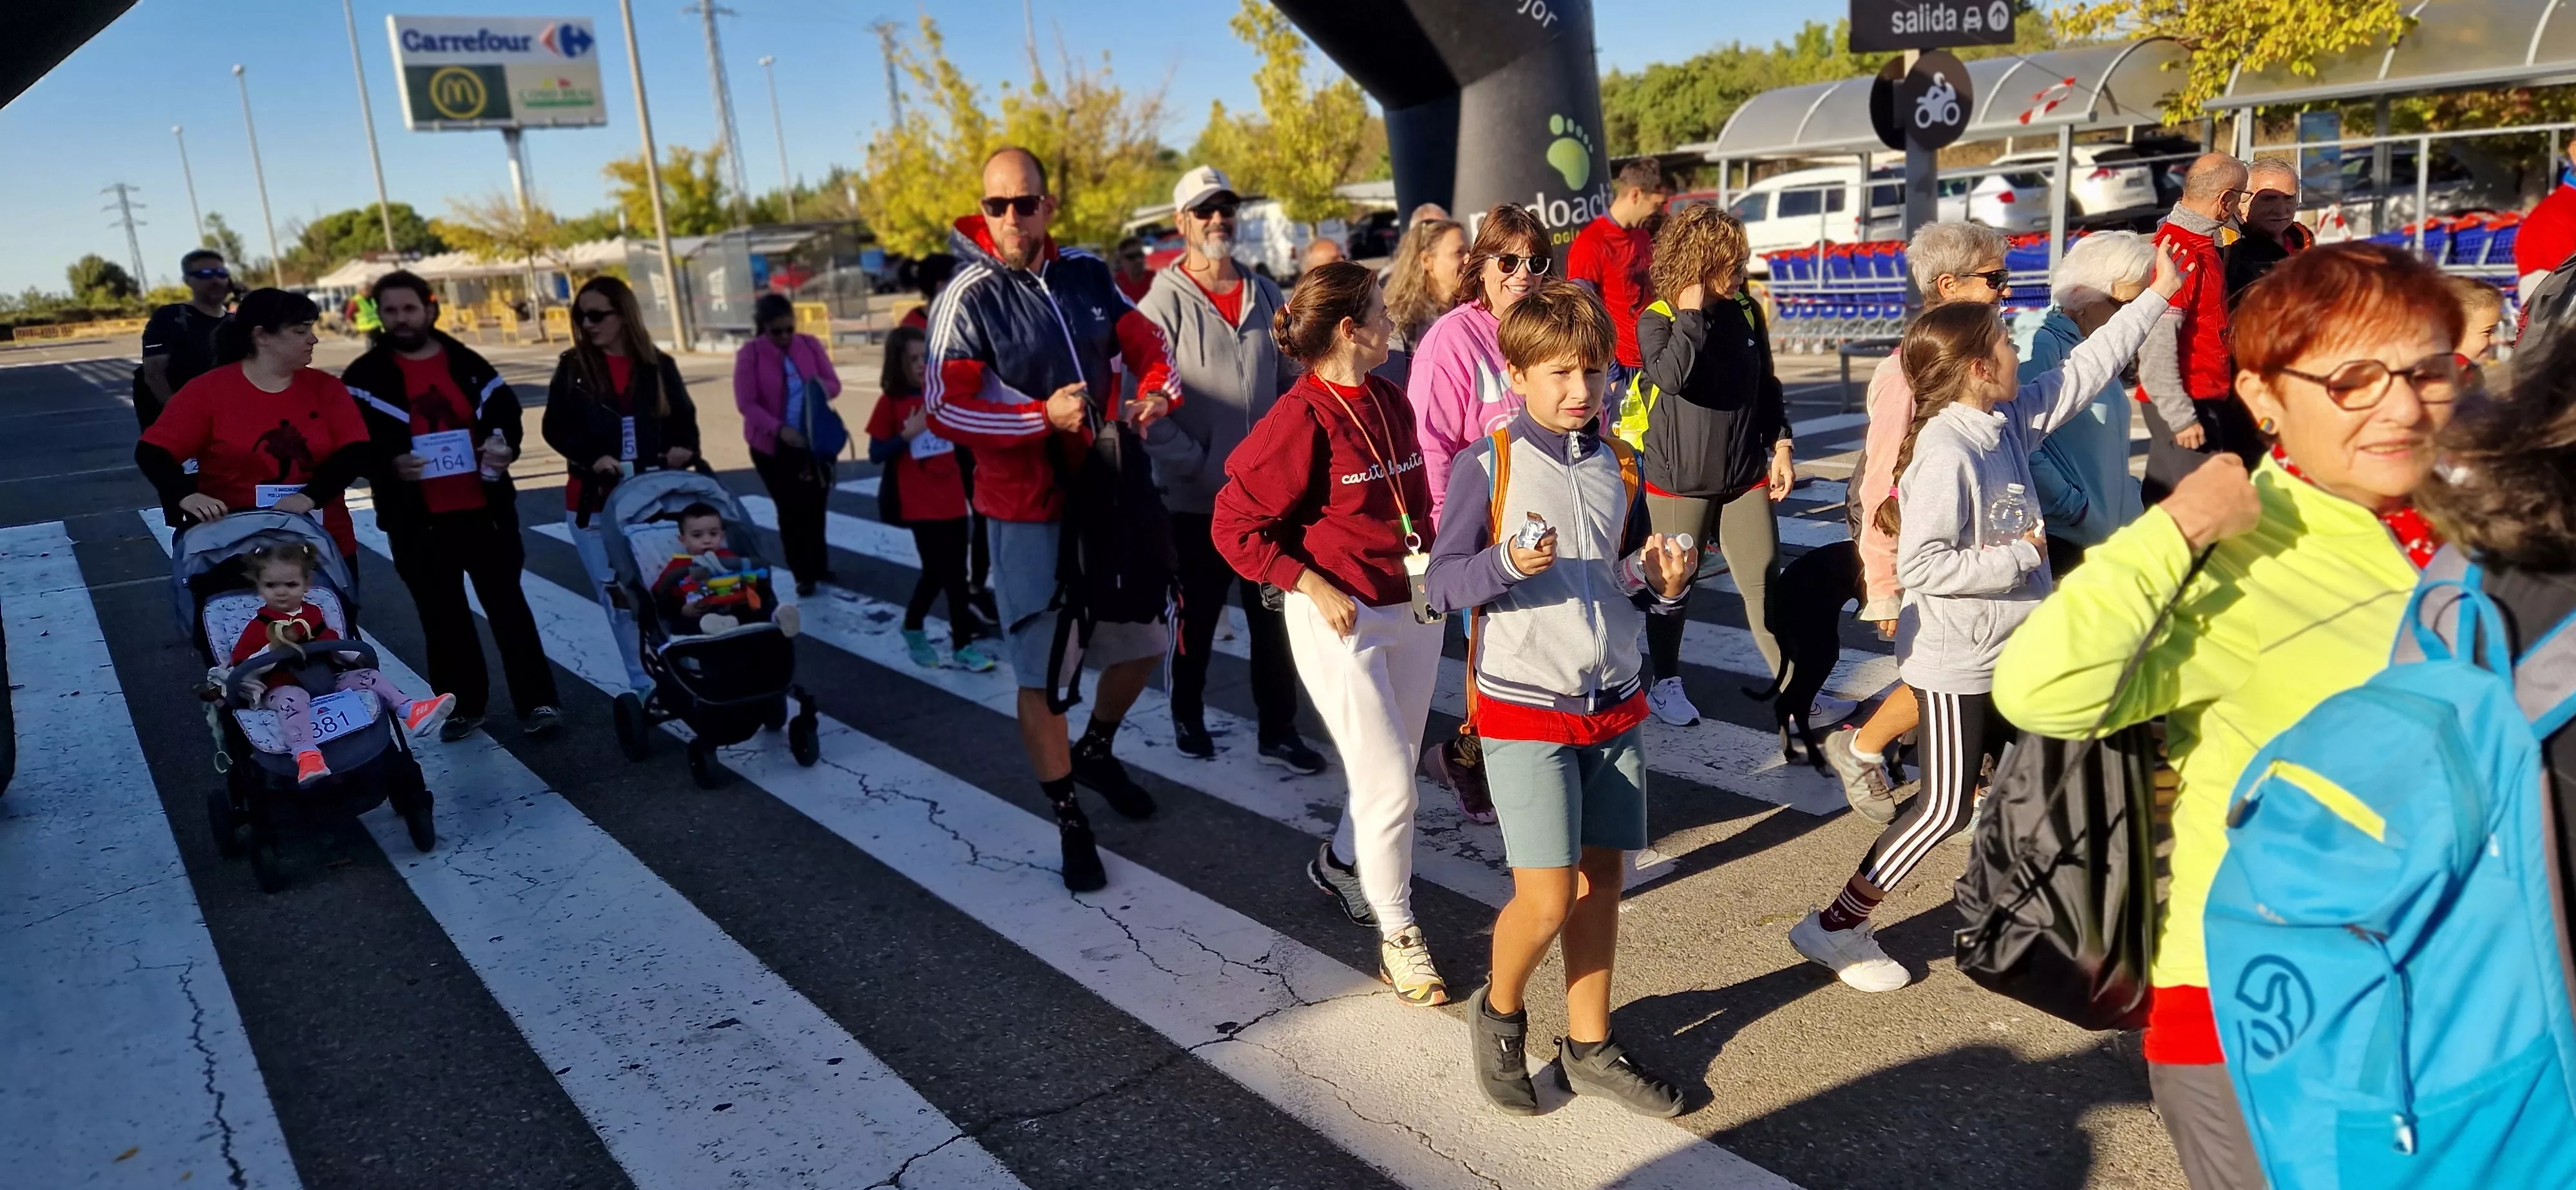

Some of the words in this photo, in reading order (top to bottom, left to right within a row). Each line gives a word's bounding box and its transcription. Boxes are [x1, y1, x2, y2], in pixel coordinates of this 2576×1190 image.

[1517, 0, 1558, 28] jor
[1891, 3, 1956, 33] salida
[401, 28, 532, 53] Carrefour
[431, 453, 465, 471] 164
[310, 710, 350, 739] 381
